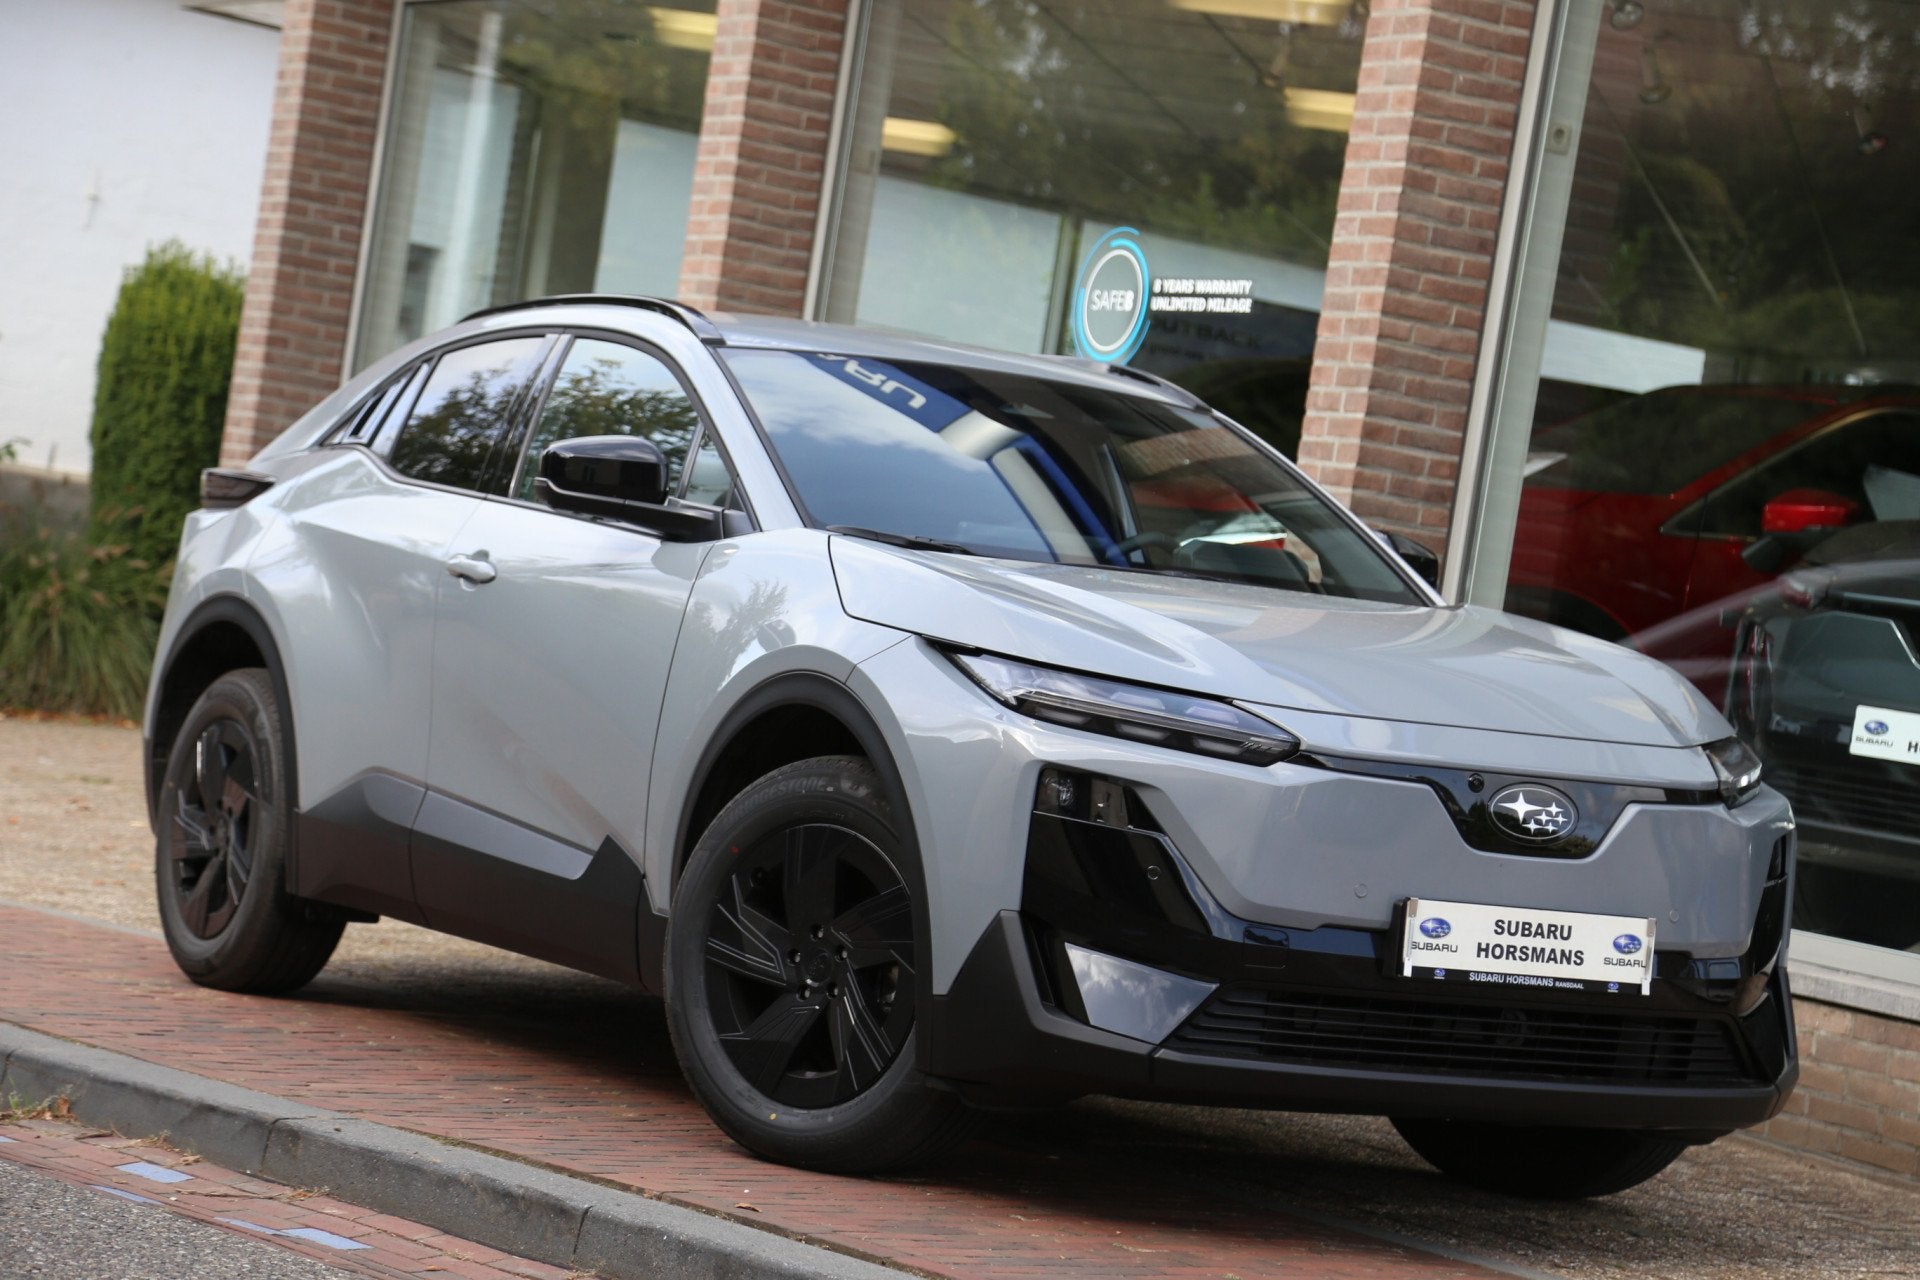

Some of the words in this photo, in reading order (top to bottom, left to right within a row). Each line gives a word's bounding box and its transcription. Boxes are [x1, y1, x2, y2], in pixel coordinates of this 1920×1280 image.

[1153, 279, 1161, 293] 8
[1163, 279, 1194, 294] YEARS
[1195, 279, 1252, 294] WARRANTY
[1151, 296, 1206, 312] UNLIMITED
[1206, 297, 1252, 313] MILEAGE
[1907, 741, 1920, 753] H
[1494, 919, 1572, 941] SUBARU
[1411, 941, 1458, 953] SUBARU
[1477, 942, 1584, 966] HORSMANS
[1469, 972, 1504, 983] SUBARU
[1506, 975, 1554, 987] HORSMANS
